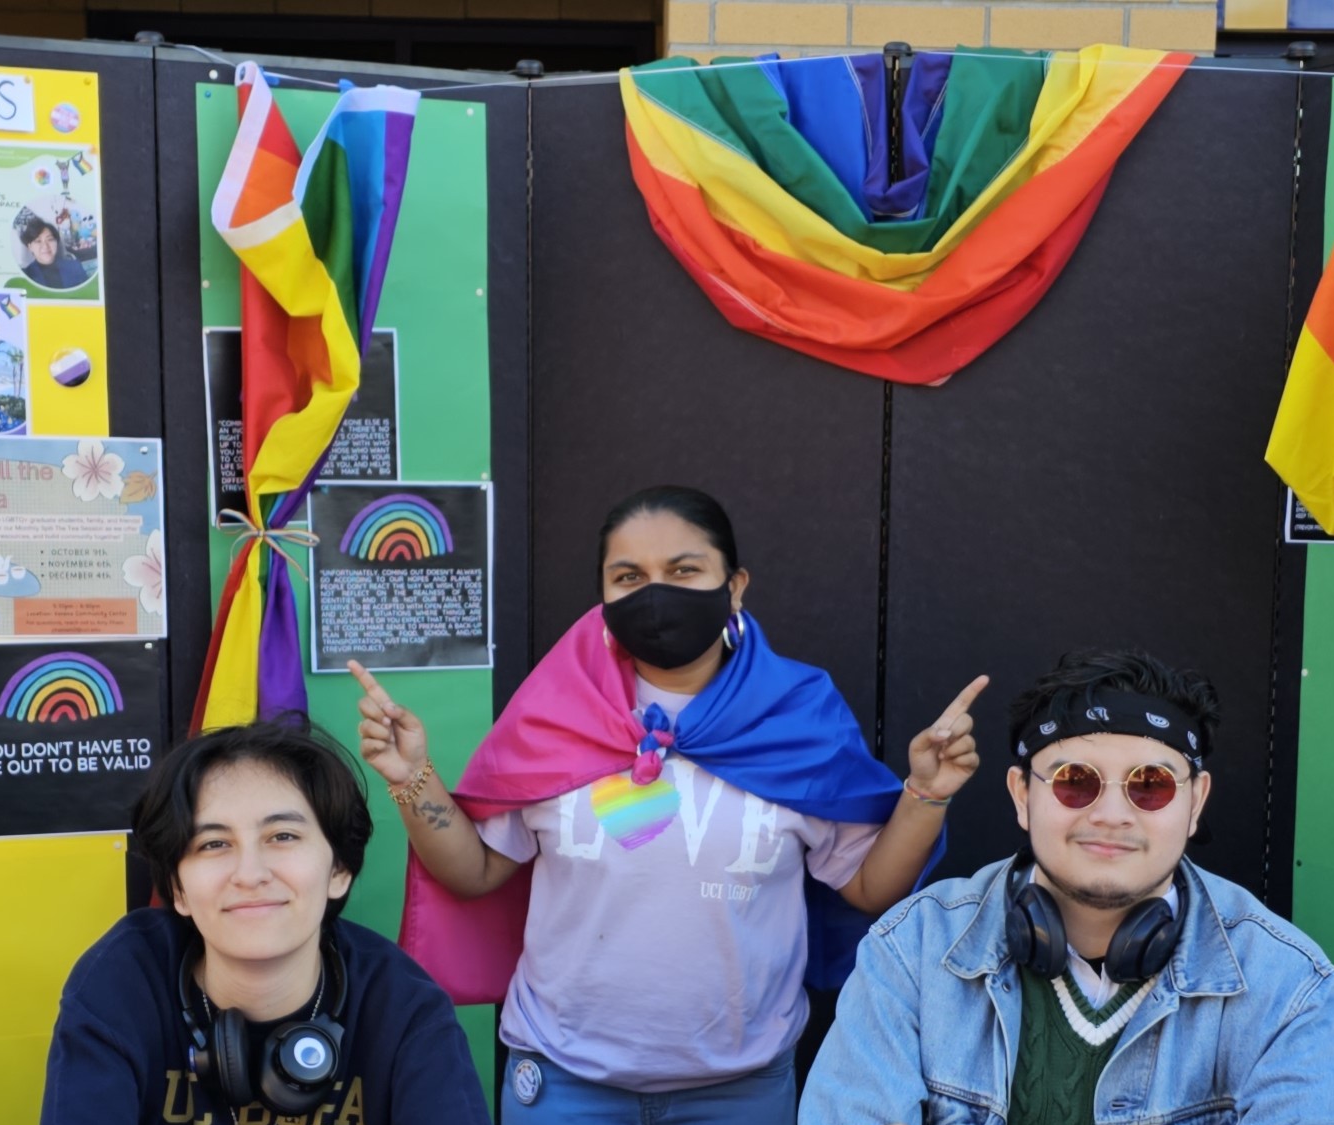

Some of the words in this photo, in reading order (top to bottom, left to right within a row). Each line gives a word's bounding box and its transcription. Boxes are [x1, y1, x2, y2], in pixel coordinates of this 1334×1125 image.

[18, 461, 53, 480] the
[22, 741, 73, 757] DON'T
[79, 740, 121, 755] HAVE
[127, 739, 150, 753] TO
[7, 759, 45, 774] OUT
[49, 758, 72, 773] TO
[78, 757, 98, 772] BE
[103, 755, 151, 771] VALID
